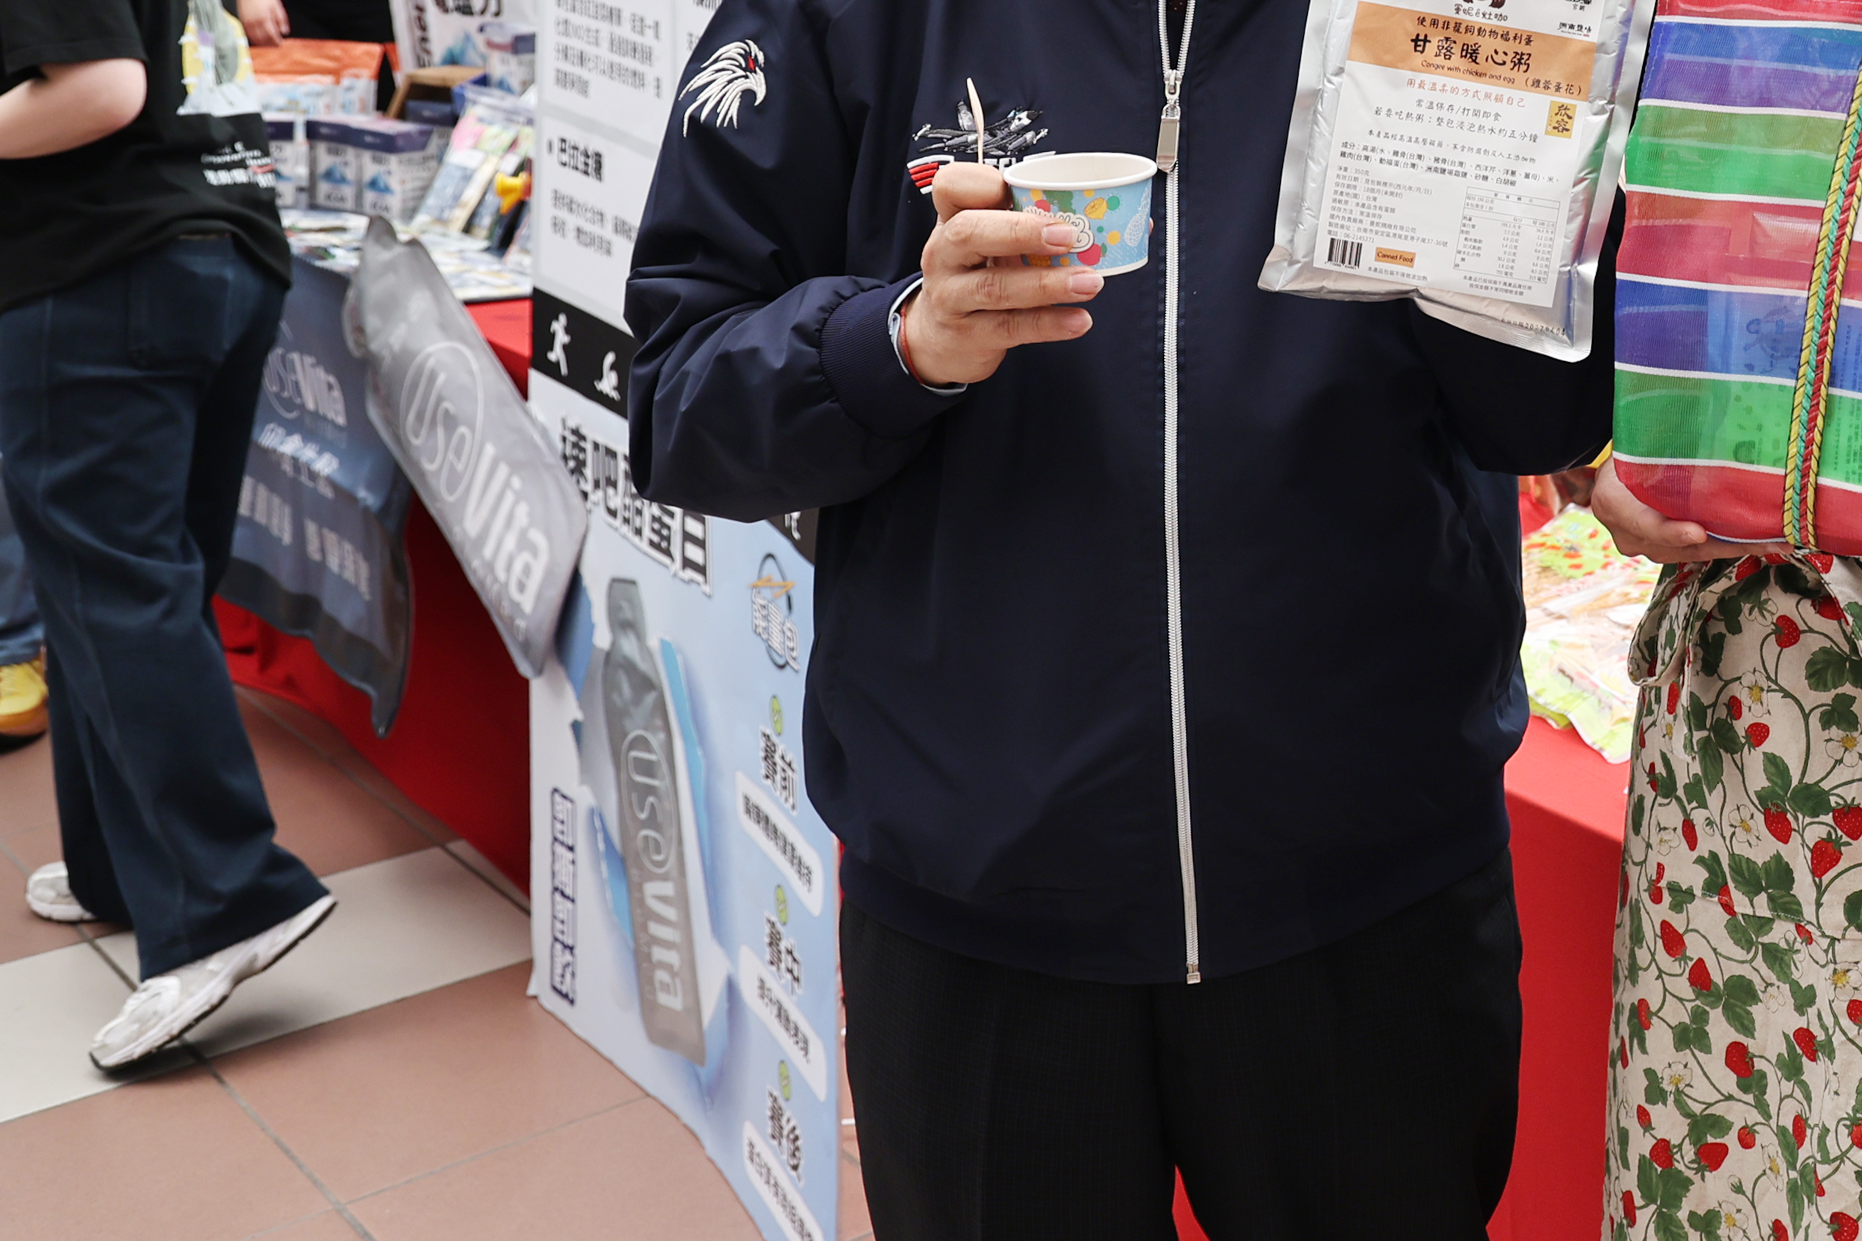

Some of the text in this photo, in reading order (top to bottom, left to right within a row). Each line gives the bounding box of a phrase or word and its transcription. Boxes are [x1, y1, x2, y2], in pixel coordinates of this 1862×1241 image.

[1416, 15, 1534, 46] 使用非籠飼動物福利蛋
[1408, 30, 1532, 73] 甘露暖心粥
[1420, 59, 1515, 85] Congee with chicken and egg
[1405, 77, 1526, 107] 用最溫柔的方式照顧自己
[1414, 98, 1502, 122] 常溫保存/打開即食
[1376, 250, 1413, 263] Canned Food
[627, 745, 684, 1013] UseVita
